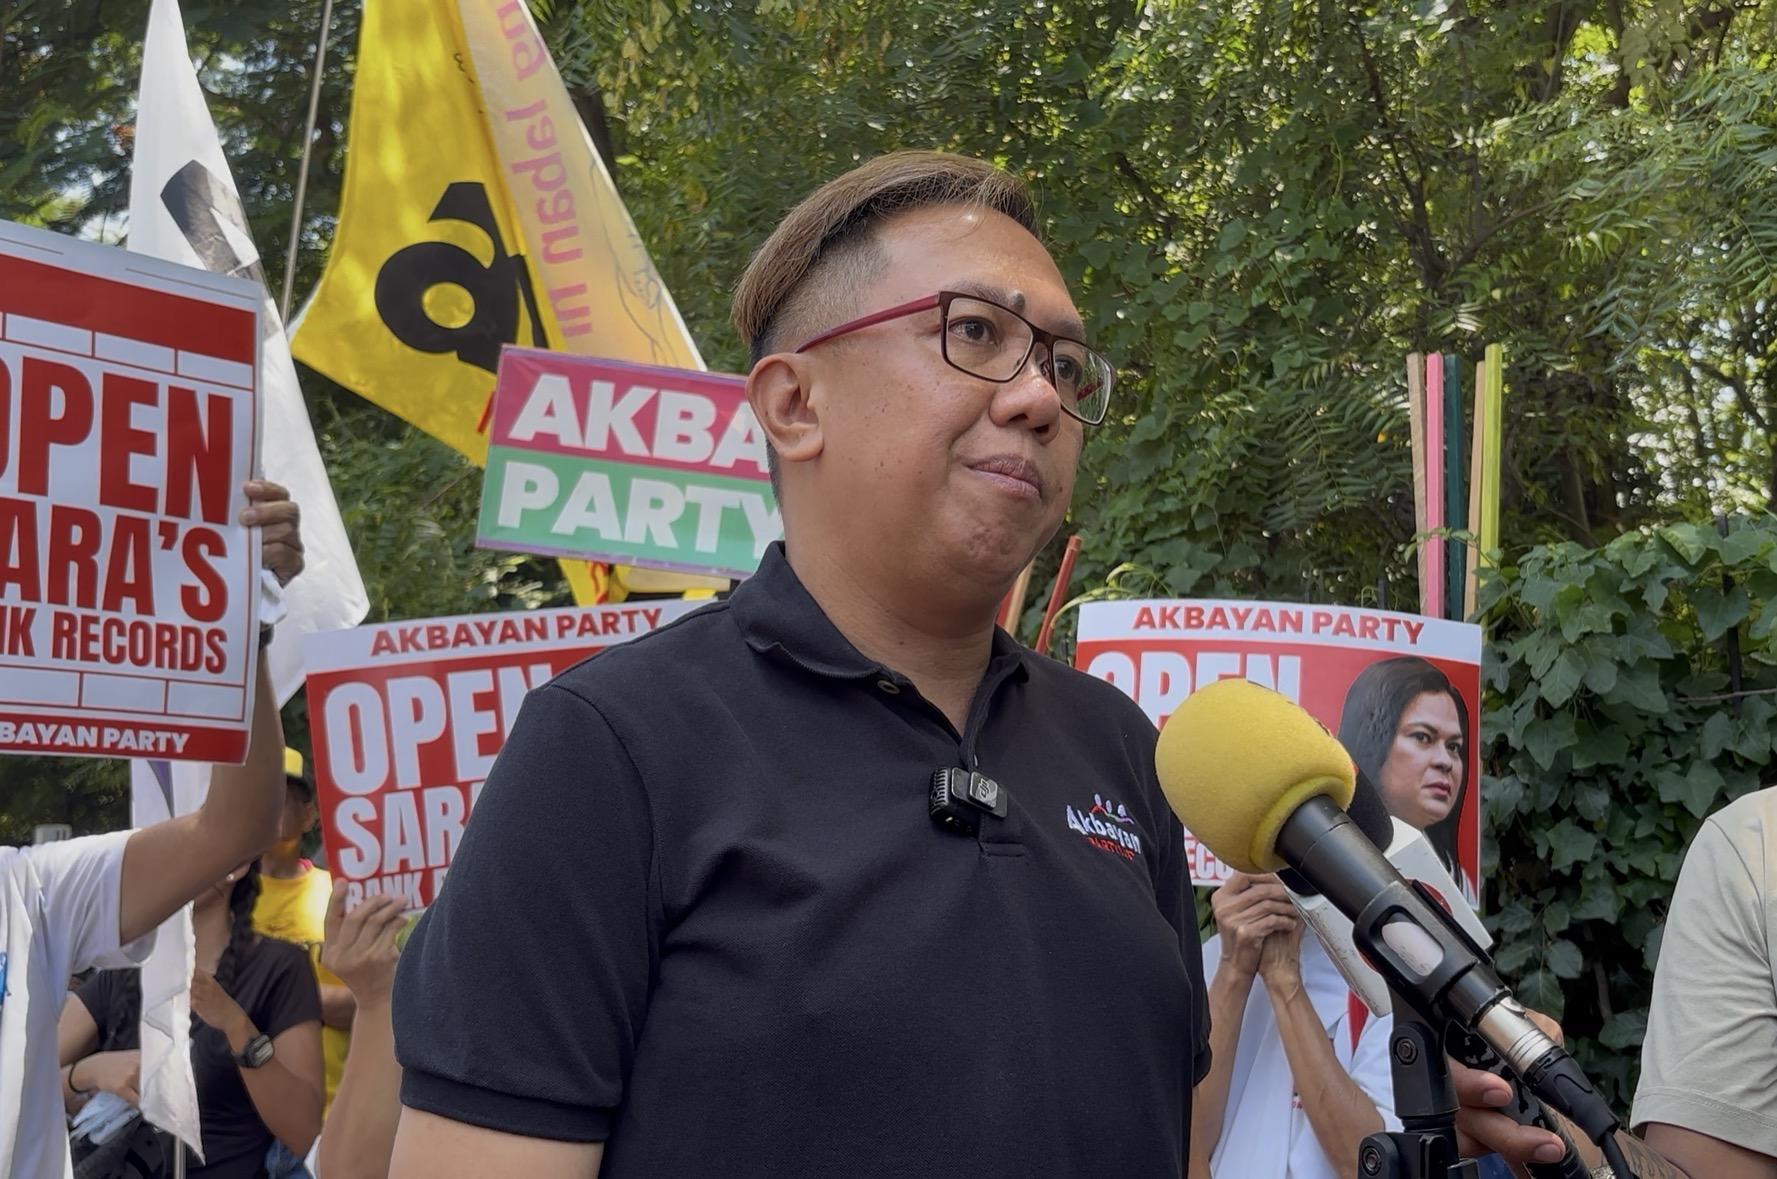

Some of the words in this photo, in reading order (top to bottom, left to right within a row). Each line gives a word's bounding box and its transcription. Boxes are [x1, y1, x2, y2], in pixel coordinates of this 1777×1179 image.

[0, 355, 233, 526] PEN
[497, 461, 786, 560] PARTY
[52, 611, 228, 675] RECORDS
[371, 615, 549, 657] AKBAYAN
[556, 607, 663, 640] PARTY
[1132, 606, 1303, 633] AKBAYAN
[1312, 610, 1425, 645] PARTY
[103, 727, 190, 753] PARTY
[334, 781, 484, 880] SAR
[1066, 804, 1141, 854] Akbayan
